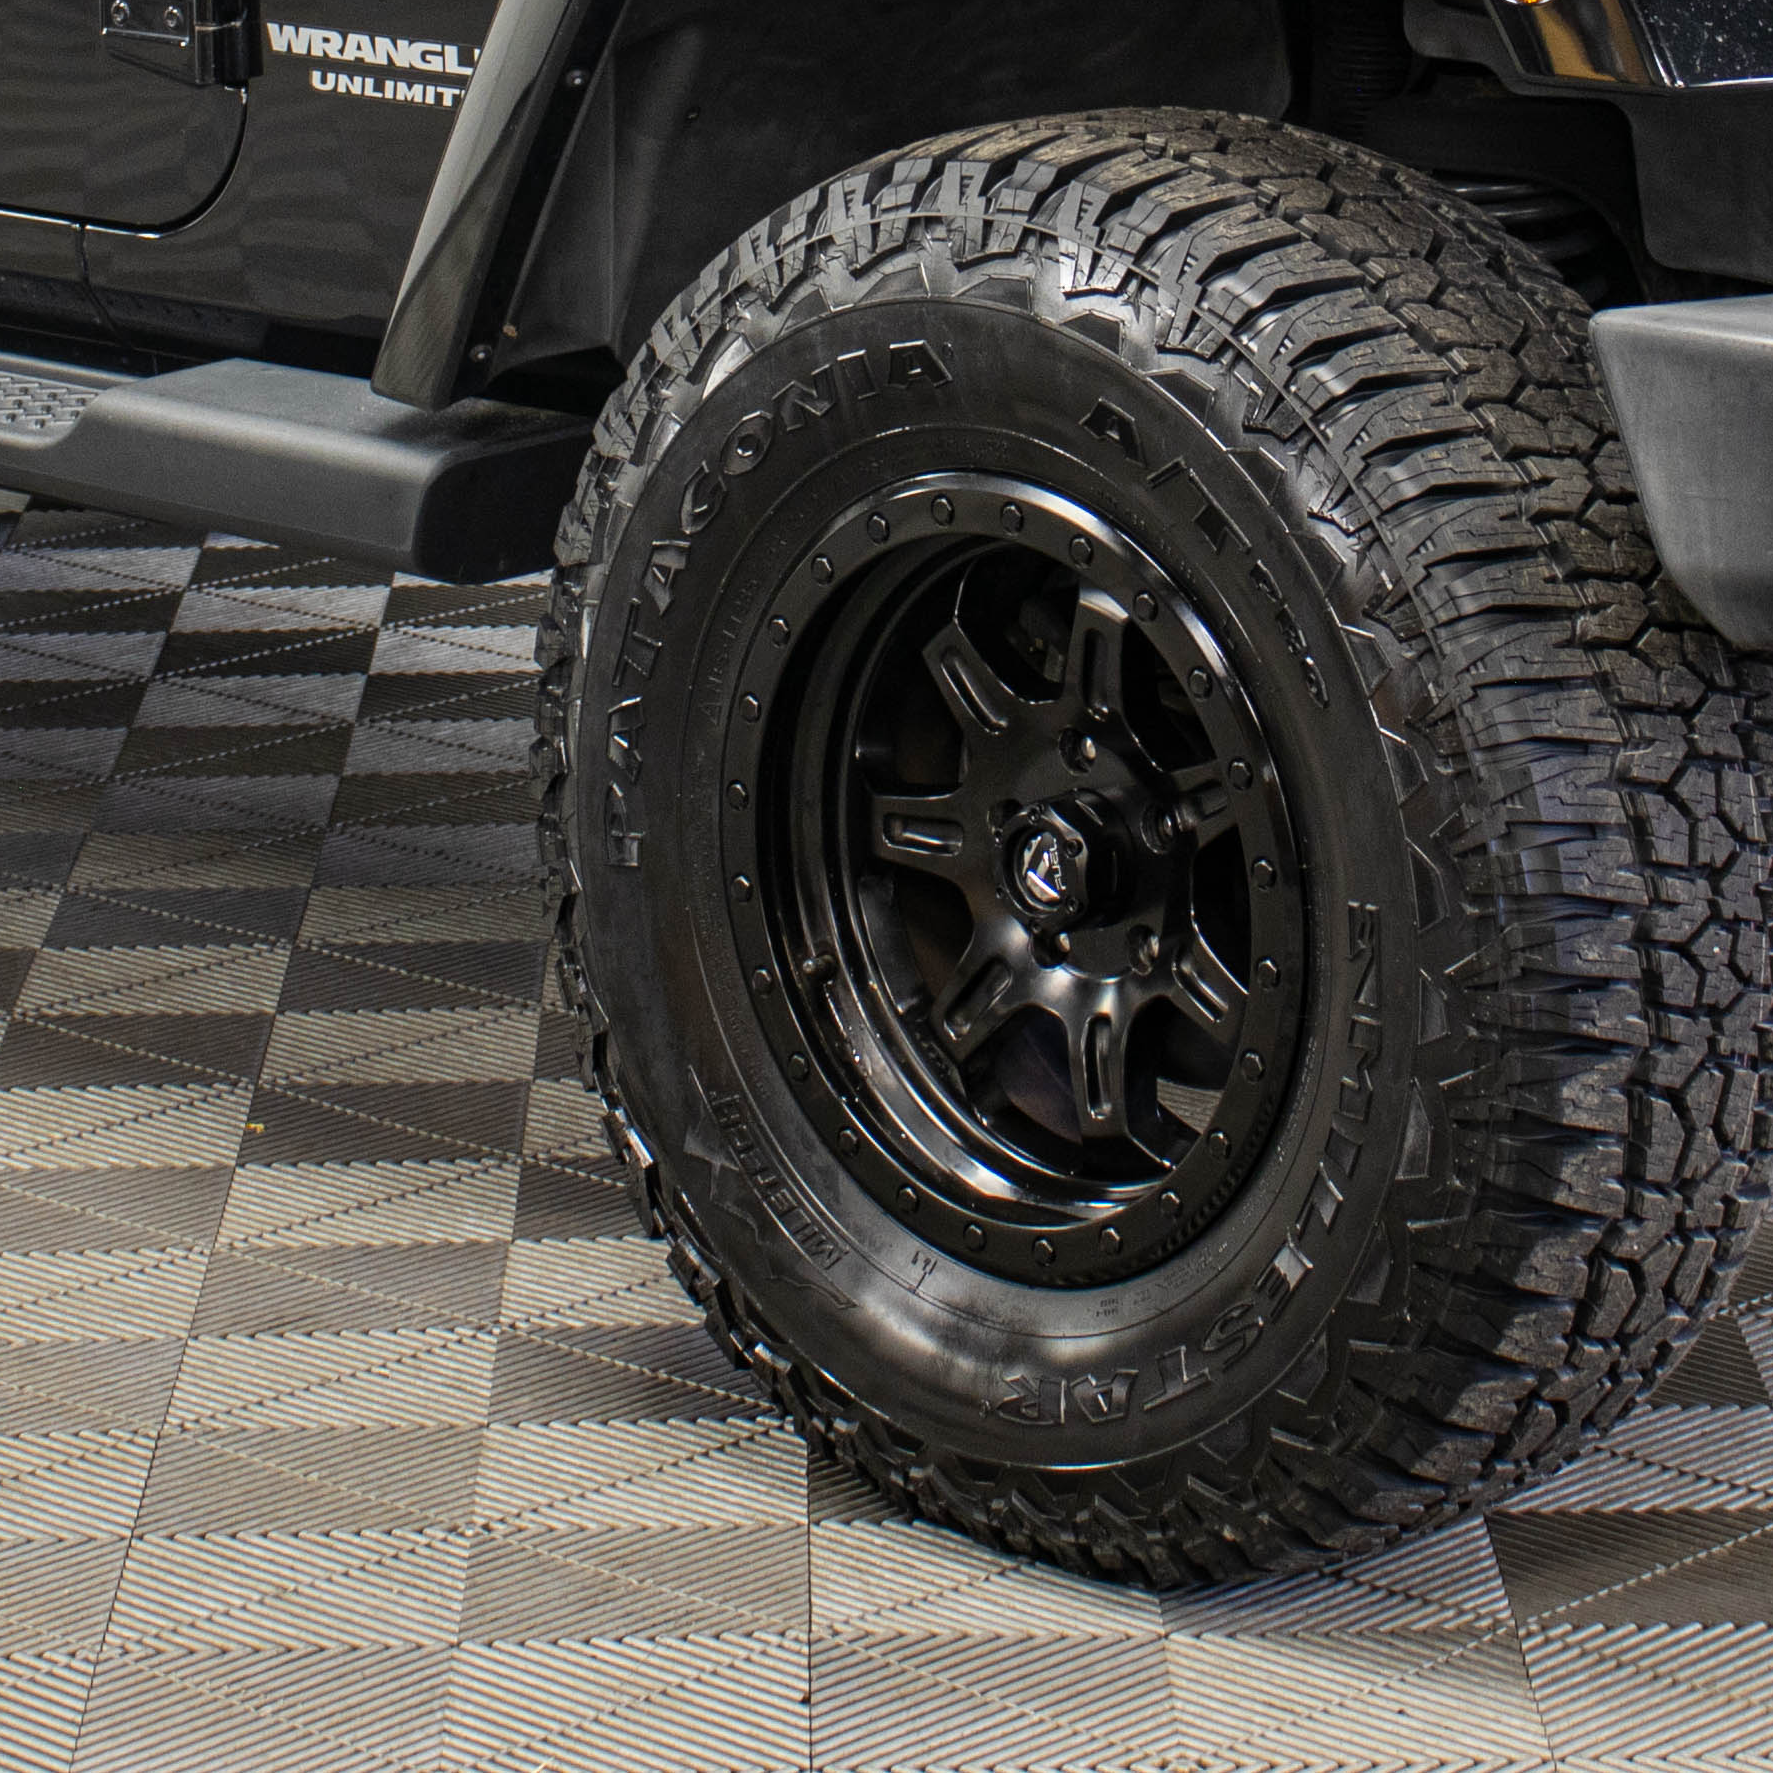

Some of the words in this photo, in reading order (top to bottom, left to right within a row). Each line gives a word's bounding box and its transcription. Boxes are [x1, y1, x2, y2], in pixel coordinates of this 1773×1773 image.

[266, 22, 480, 76] WRANGL
[310, 69, 465, 107] UNLIMIT
[603, 338, 953, 868] PATAGONIA
[1049, 838, 1066, 890] FUEL
[994, 1016, 1384, 1425] MILESTAR
